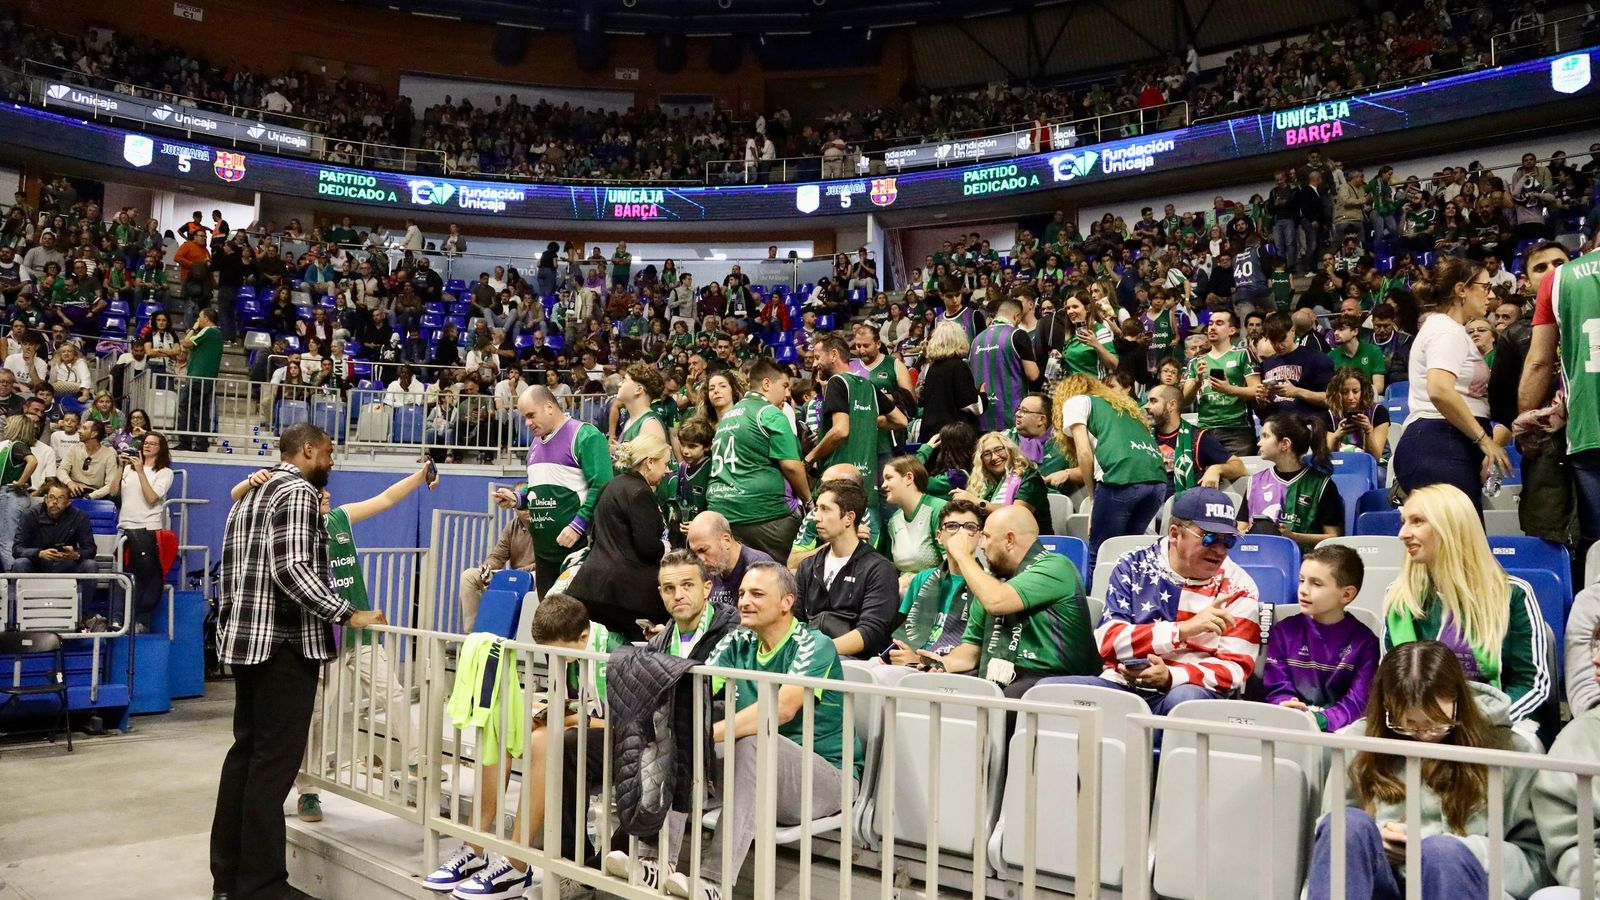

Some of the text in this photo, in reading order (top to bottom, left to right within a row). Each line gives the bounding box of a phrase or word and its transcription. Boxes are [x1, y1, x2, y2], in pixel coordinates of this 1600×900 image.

[72, 91, 118, 110] Unicaja
[174, 112, 217, 130] Unicaja
[1276, 101, 1350, 129] UNICAJA
[267, 130, 307, 148] Unicaja
[1286, 121, 1343, 145] BARÇA
[885, 149, 917, 159] ndación
[1102, 139, 1174, 163] Fundación
[178, 155, 191, 173] 5
[964, 164, 1018, 182] PARTIDO
[1102, 154, 1154, 174] Unicaja
[319, 170, 377, 187] PARTIDO
[964, 174, 1040, 196] DEDICADO A
[318, 183, 397, 202] DEDICADO A
[458, 185, 525, 201] Fundación
[608, 190, 664, 203] UNICAJA
[840, 191, 852, 208] 5
[458, 197, 506, 213] Unicaja
[614, 204, 658, 220] BARÇA
[1233, 261, 1253, 278] 40
[710, 435, 739, 477] 34
[535, 497, 557, 507] Unicaja
